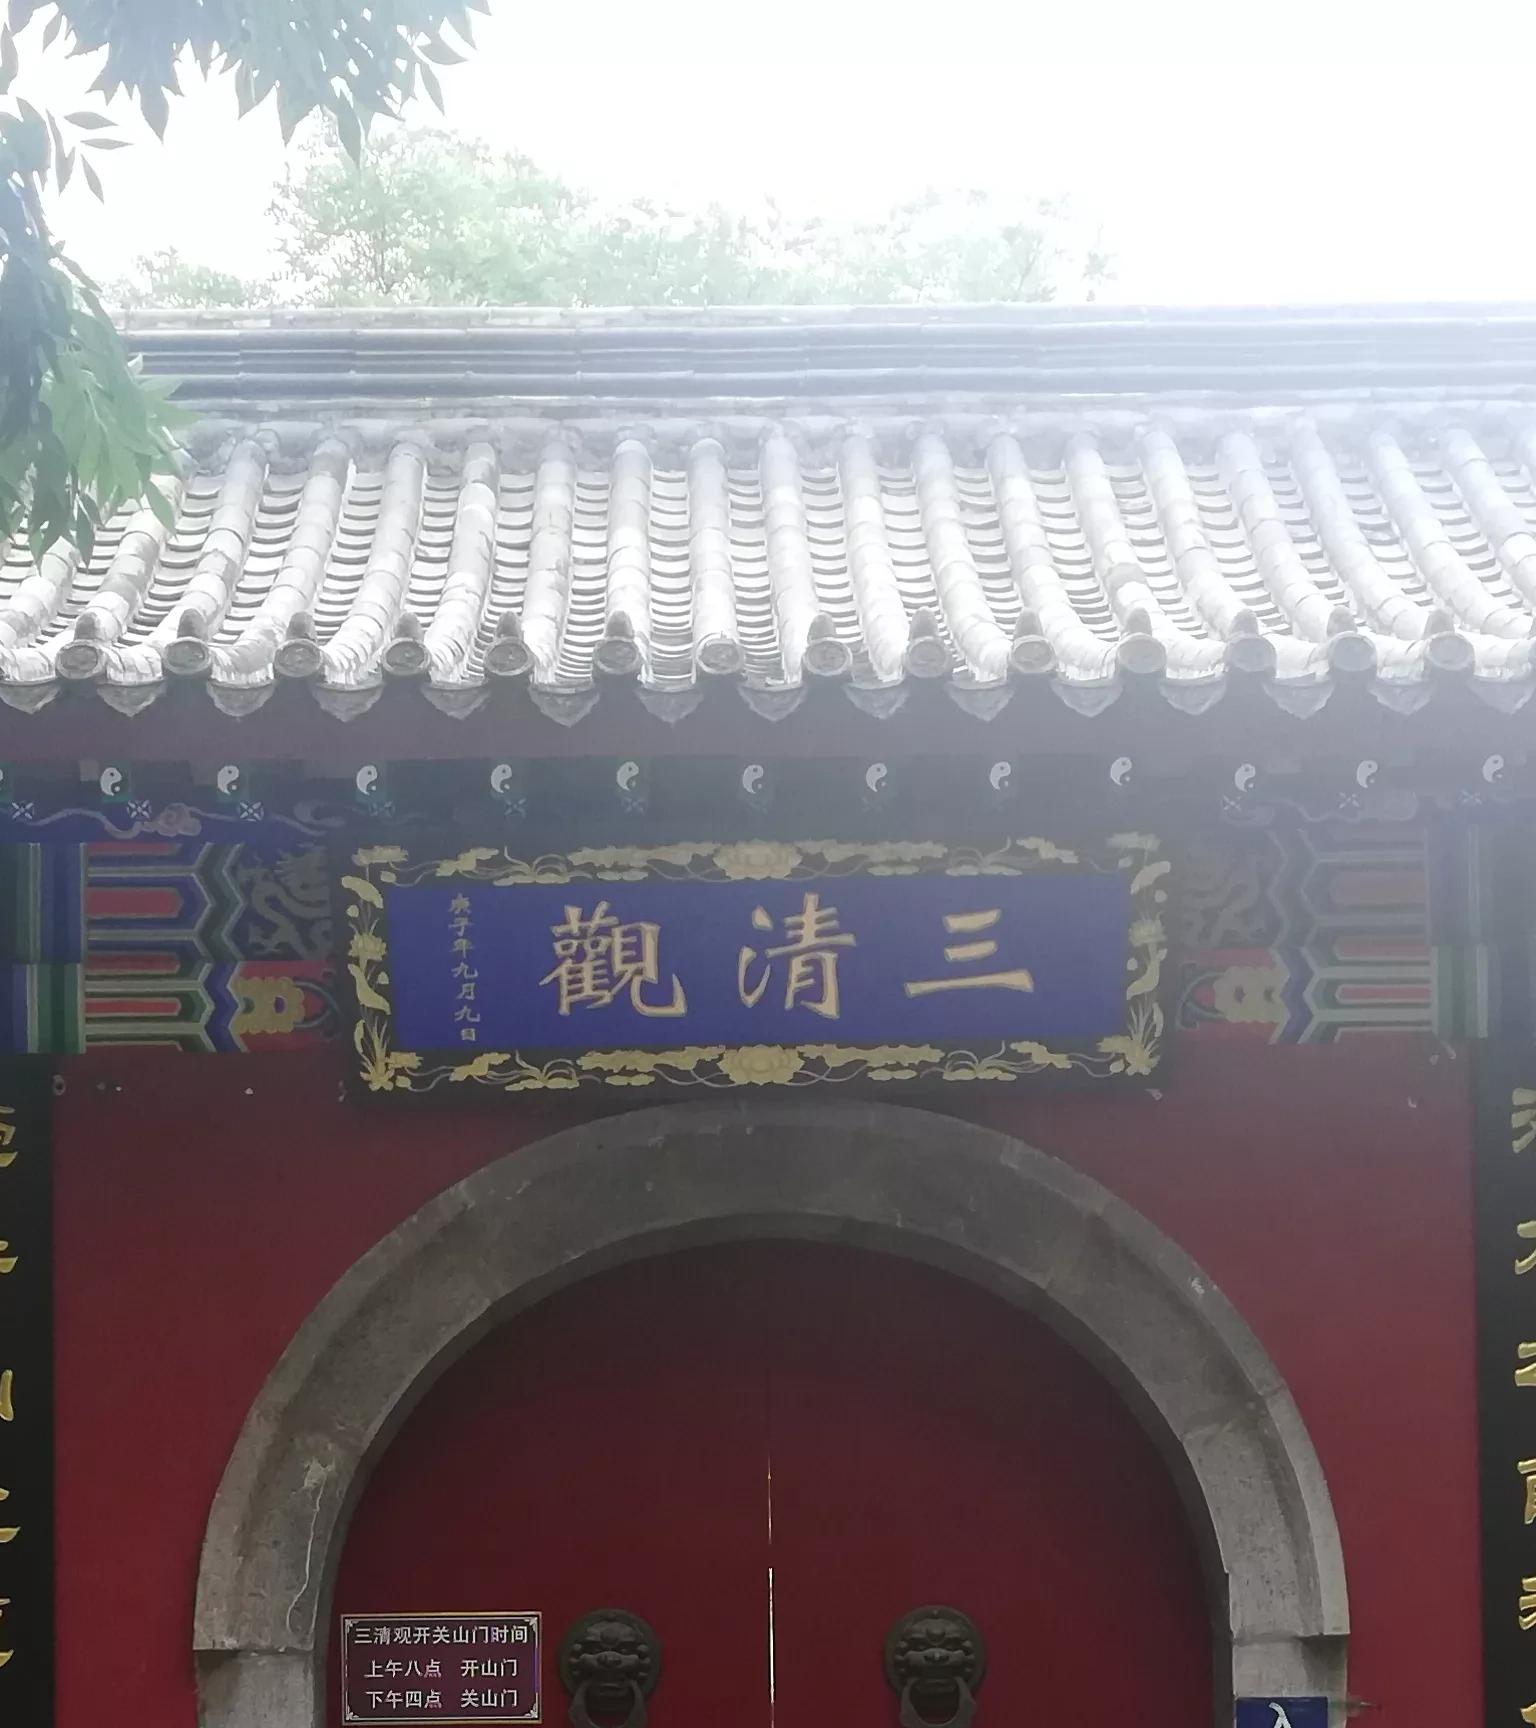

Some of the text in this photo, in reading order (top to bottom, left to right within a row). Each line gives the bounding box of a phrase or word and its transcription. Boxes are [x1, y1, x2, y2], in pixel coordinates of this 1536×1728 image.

[354, 1625, 529, 1646] 三清观开关山门时间
[364, 1658, 518, 1679] 上午八点 开山门
[365, 1689, 518, 1709] 下午四点 关山门
